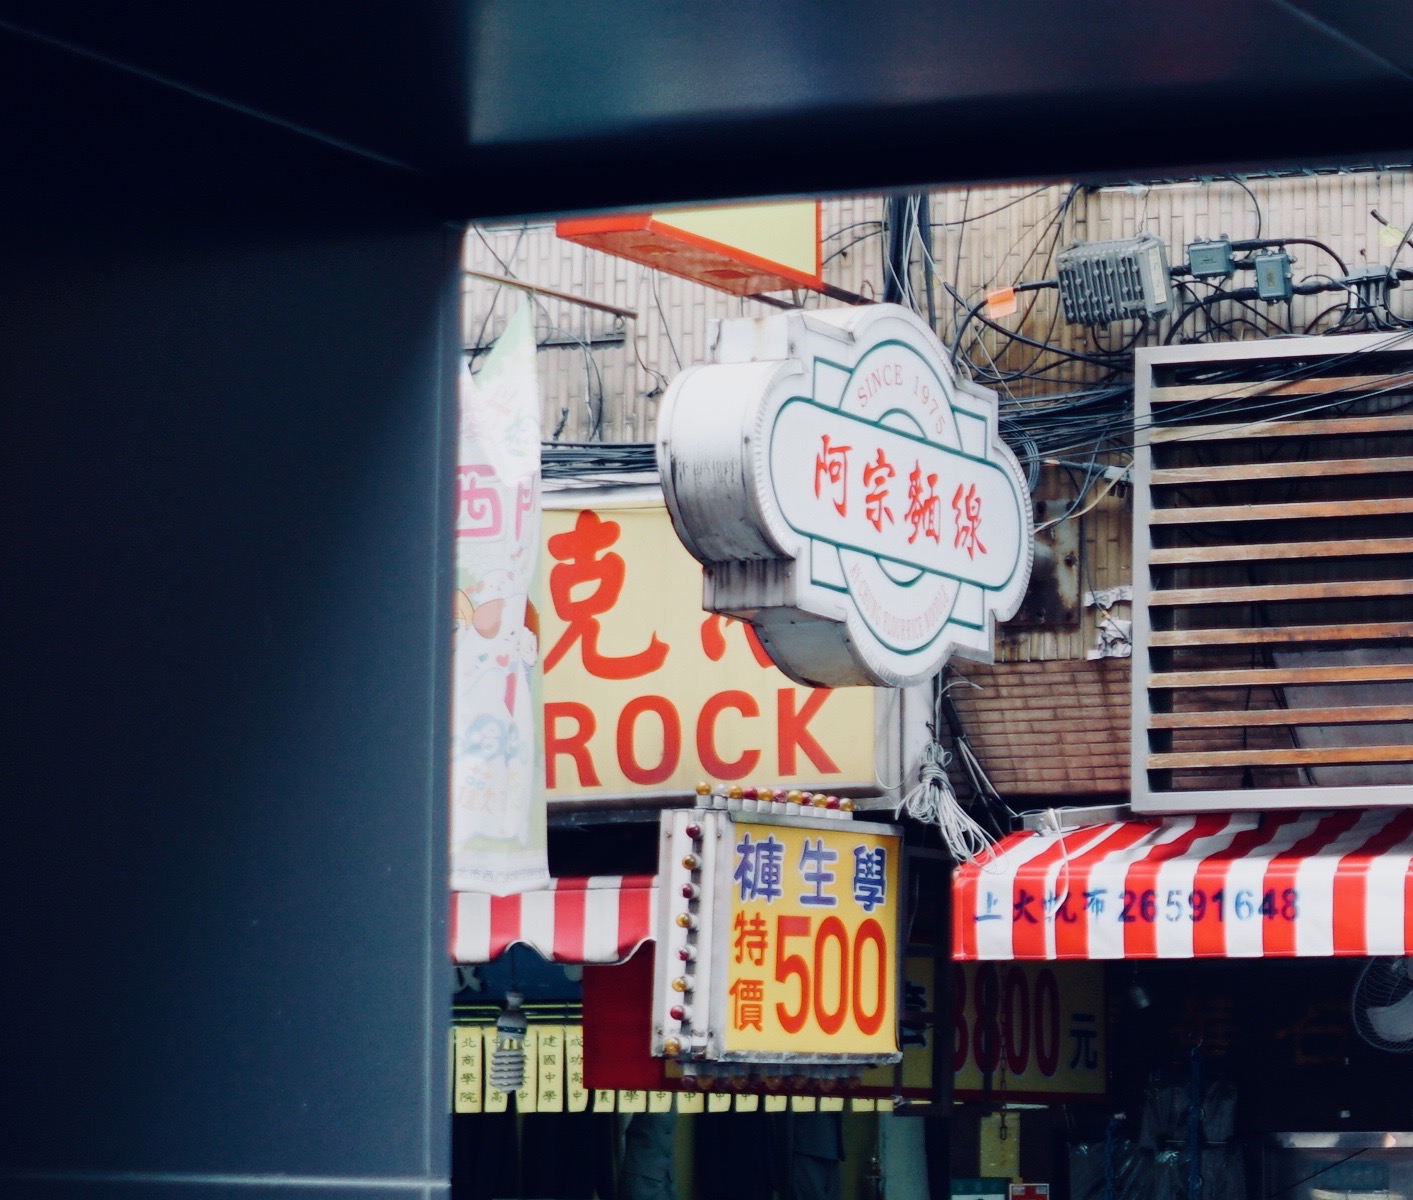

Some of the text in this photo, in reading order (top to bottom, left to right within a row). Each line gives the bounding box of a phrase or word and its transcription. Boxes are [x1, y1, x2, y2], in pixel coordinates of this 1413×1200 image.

[857, 363, 945, 435] SINCE 1975
[814, 434, 988, 561] 阿宗麵線
[544, 687, 842, 790] ROCK
[1117, 888, 1302, 923] 26591648
[729, 910, 769, 1032] 特價
[775, 914, 888, 1037] 500
[459, 1036, 478, 1104] 北商學院
[542, 1034, 558, 1103] 建國中學
[1070, 1012, 1099, 1070] 元
